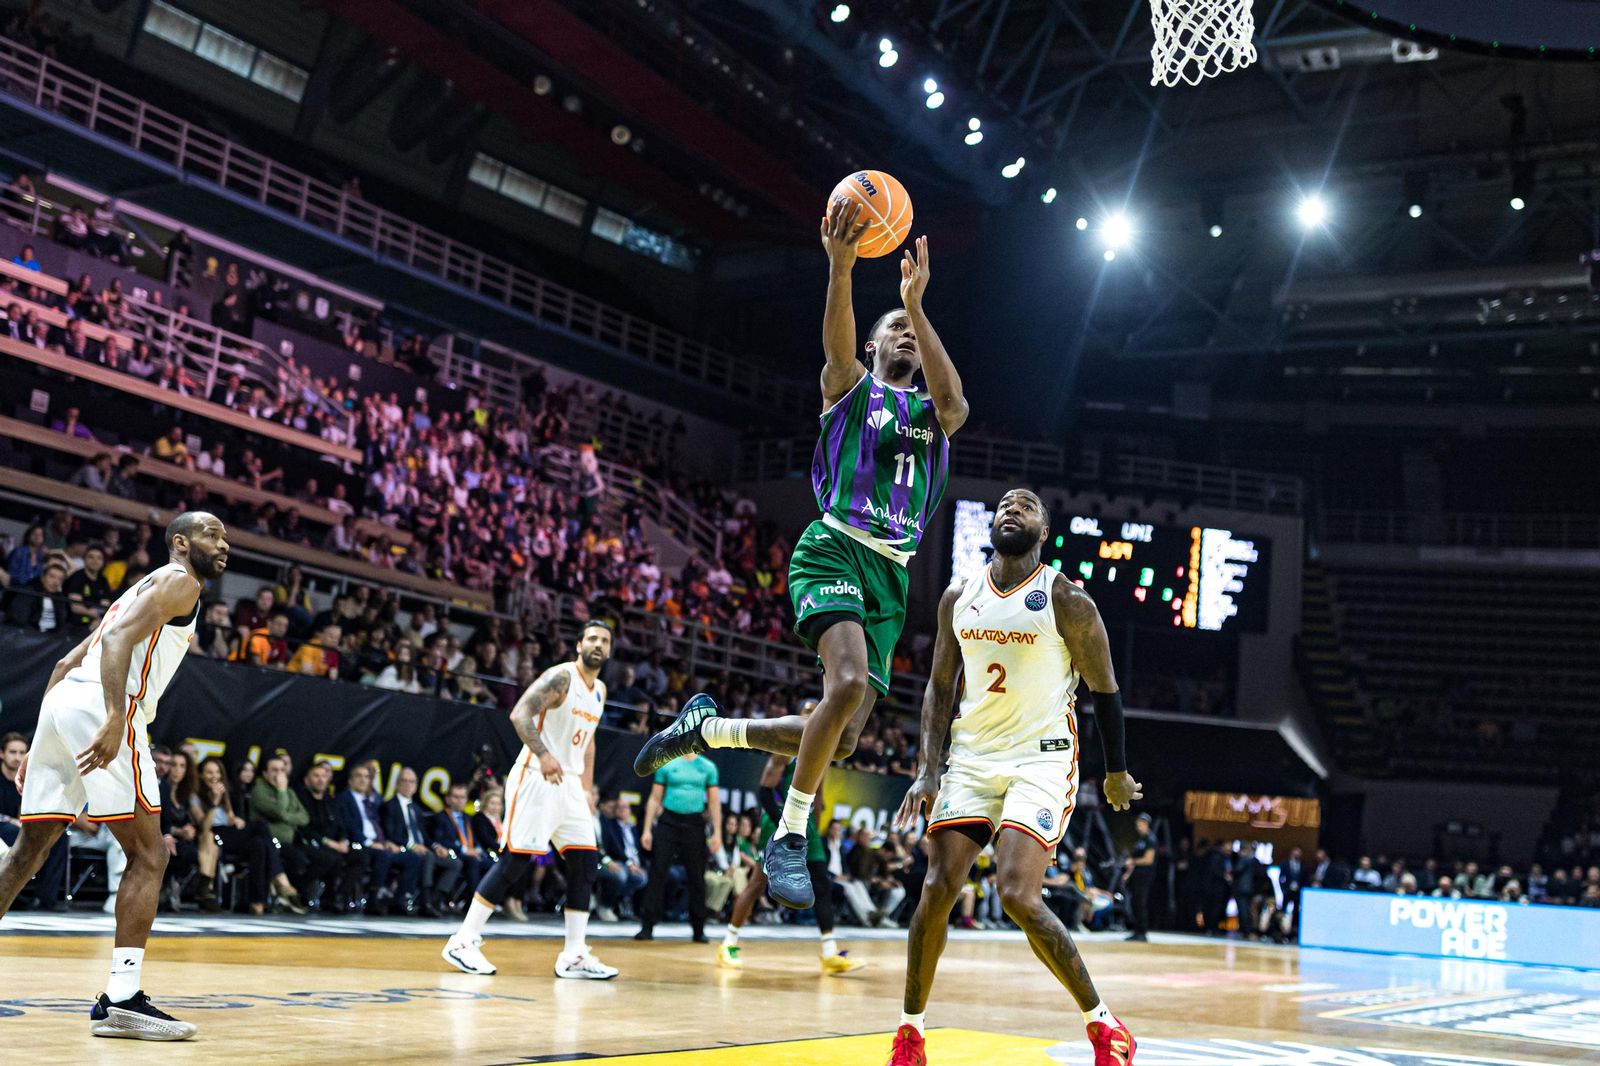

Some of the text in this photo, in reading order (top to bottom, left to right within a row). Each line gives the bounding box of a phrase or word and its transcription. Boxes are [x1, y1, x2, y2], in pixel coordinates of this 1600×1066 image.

[894, 452, 915, 488] 11
[960, 628, 1039, 645] GALATASARAY
[986, 662, 1007, 694] 2
[1390, 898, 1508, 934] POWER
[1441, 929, 1507, 960] ADE
